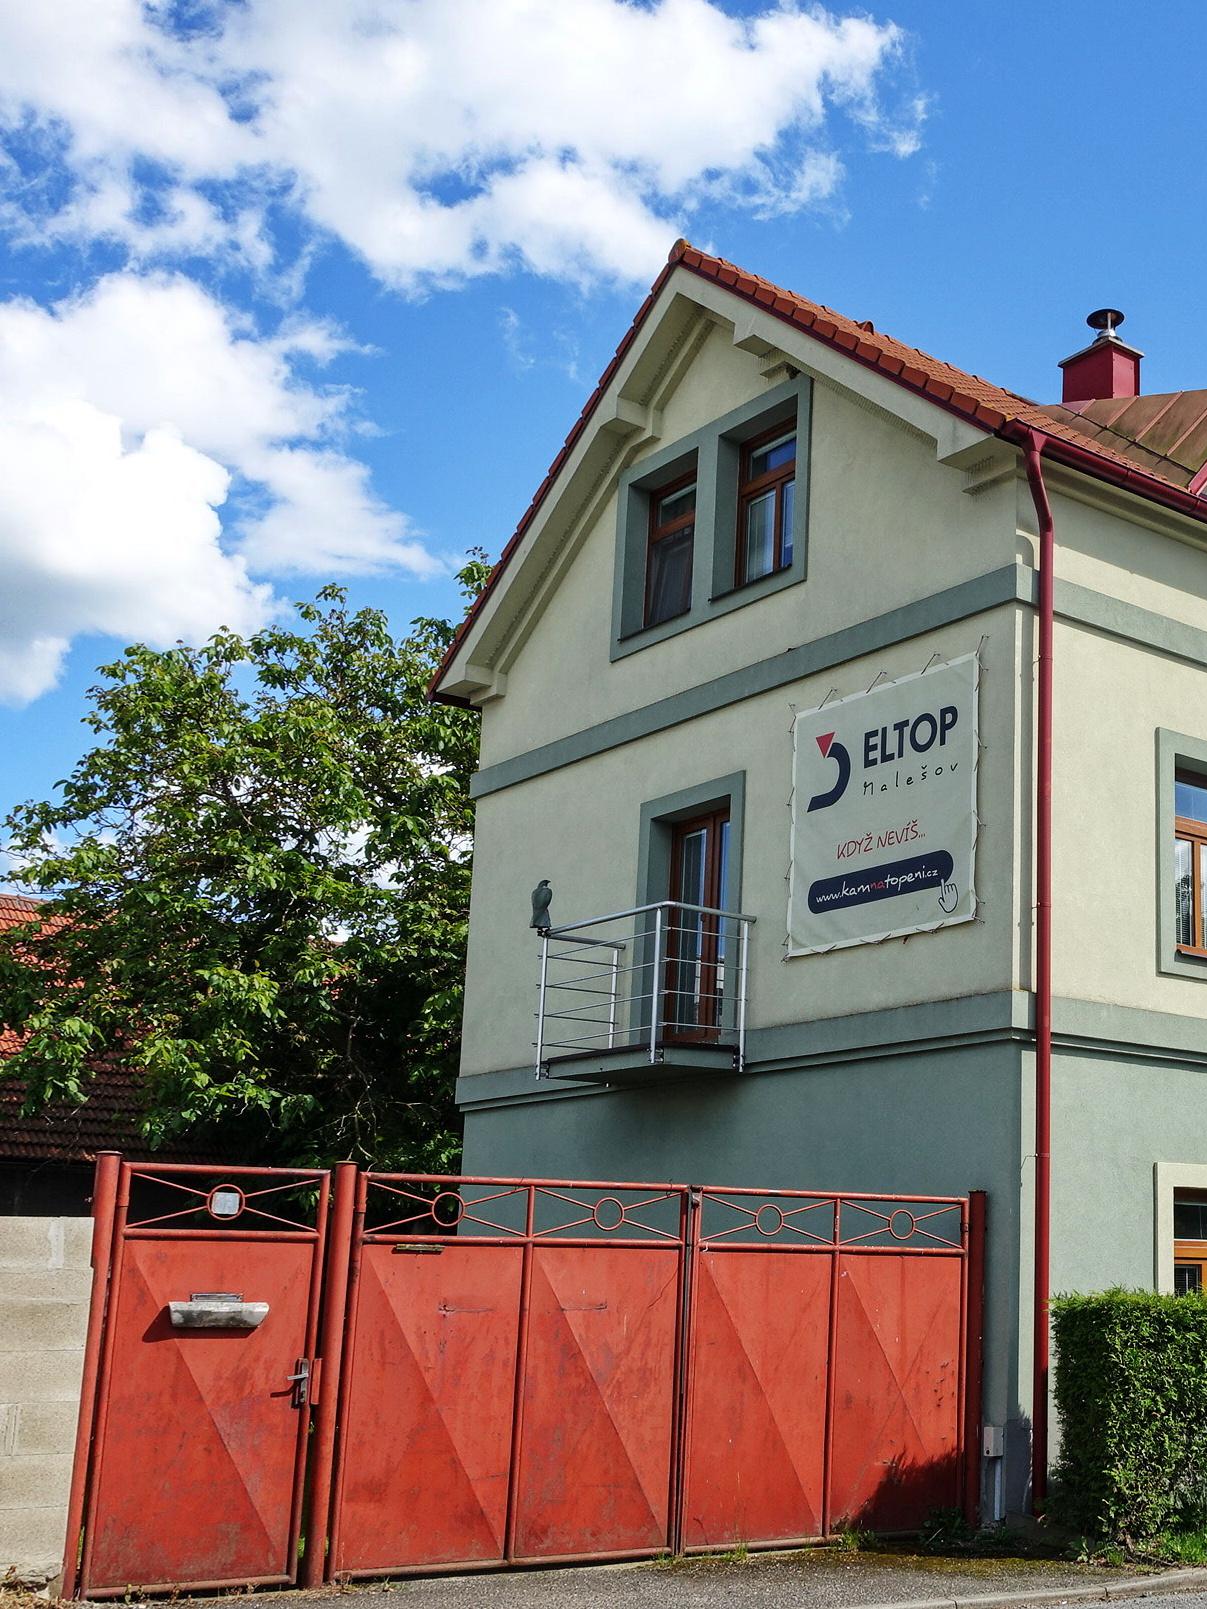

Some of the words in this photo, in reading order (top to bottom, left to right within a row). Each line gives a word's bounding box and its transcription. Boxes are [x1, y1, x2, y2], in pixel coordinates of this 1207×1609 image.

[863, 705, 958, 769] ELTOP
[863, 762, 958, 796] Malešov
[836, 832, 873, 860] KDYŽ
[876, 819, 926, 849] NEVÍŠ...
[815, 865, 939, 904] www.kamnatopeni.cz
